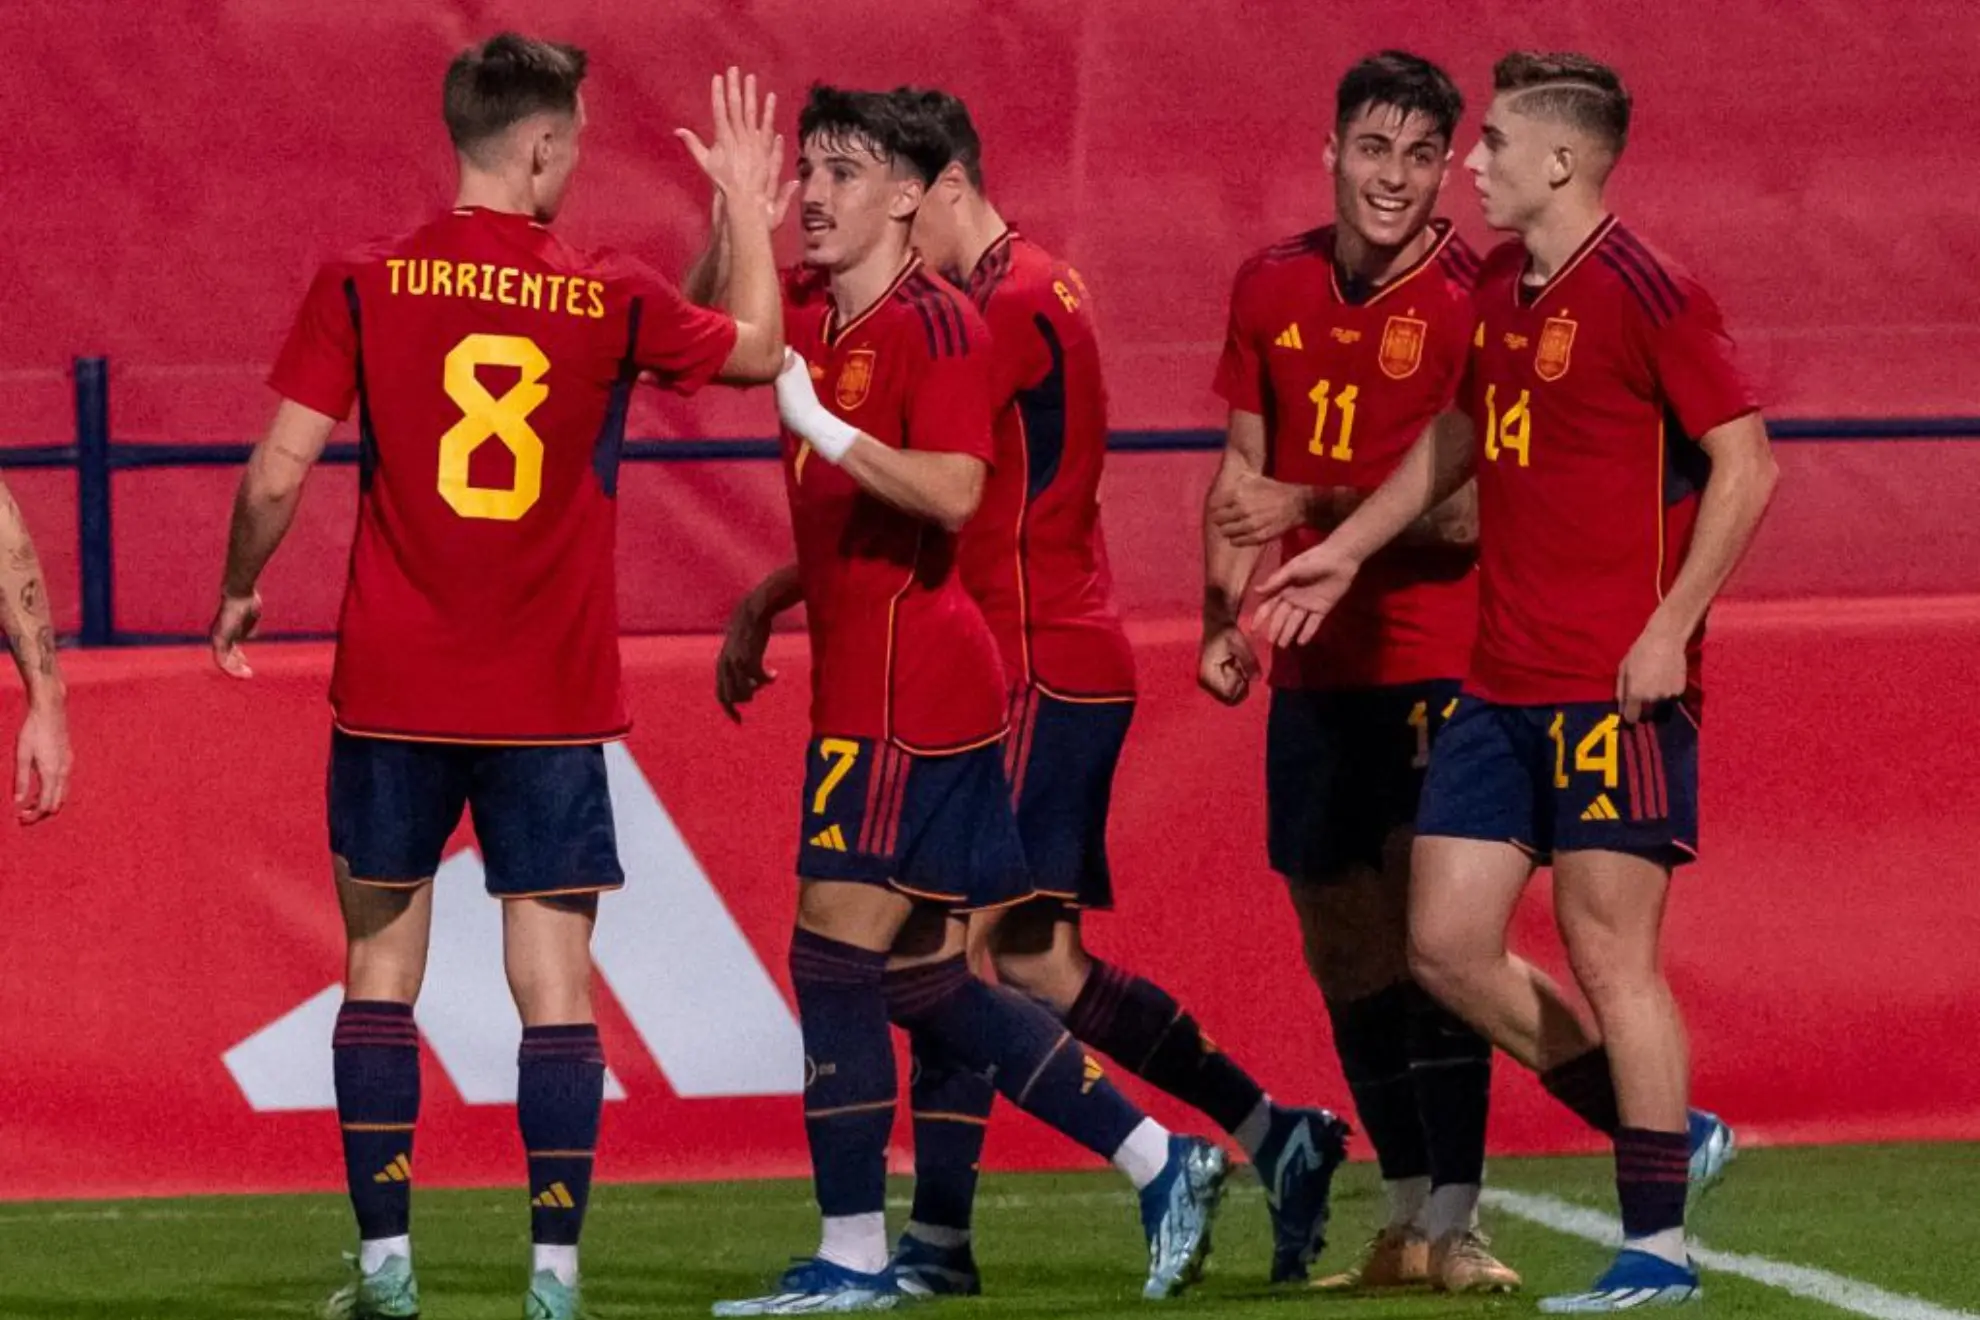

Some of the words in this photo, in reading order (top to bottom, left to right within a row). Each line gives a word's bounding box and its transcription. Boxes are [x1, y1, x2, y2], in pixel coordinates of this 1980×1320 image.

[387, 259, 604, 318] TURRIENTES
[438, 333, 551, 521] 8
[1308, 379, 1359, 462] 11
[1485, 384, 1530, 467] 14
[812, 738, 860, 814] 7
[1548, 712, 1620, 788] 14
